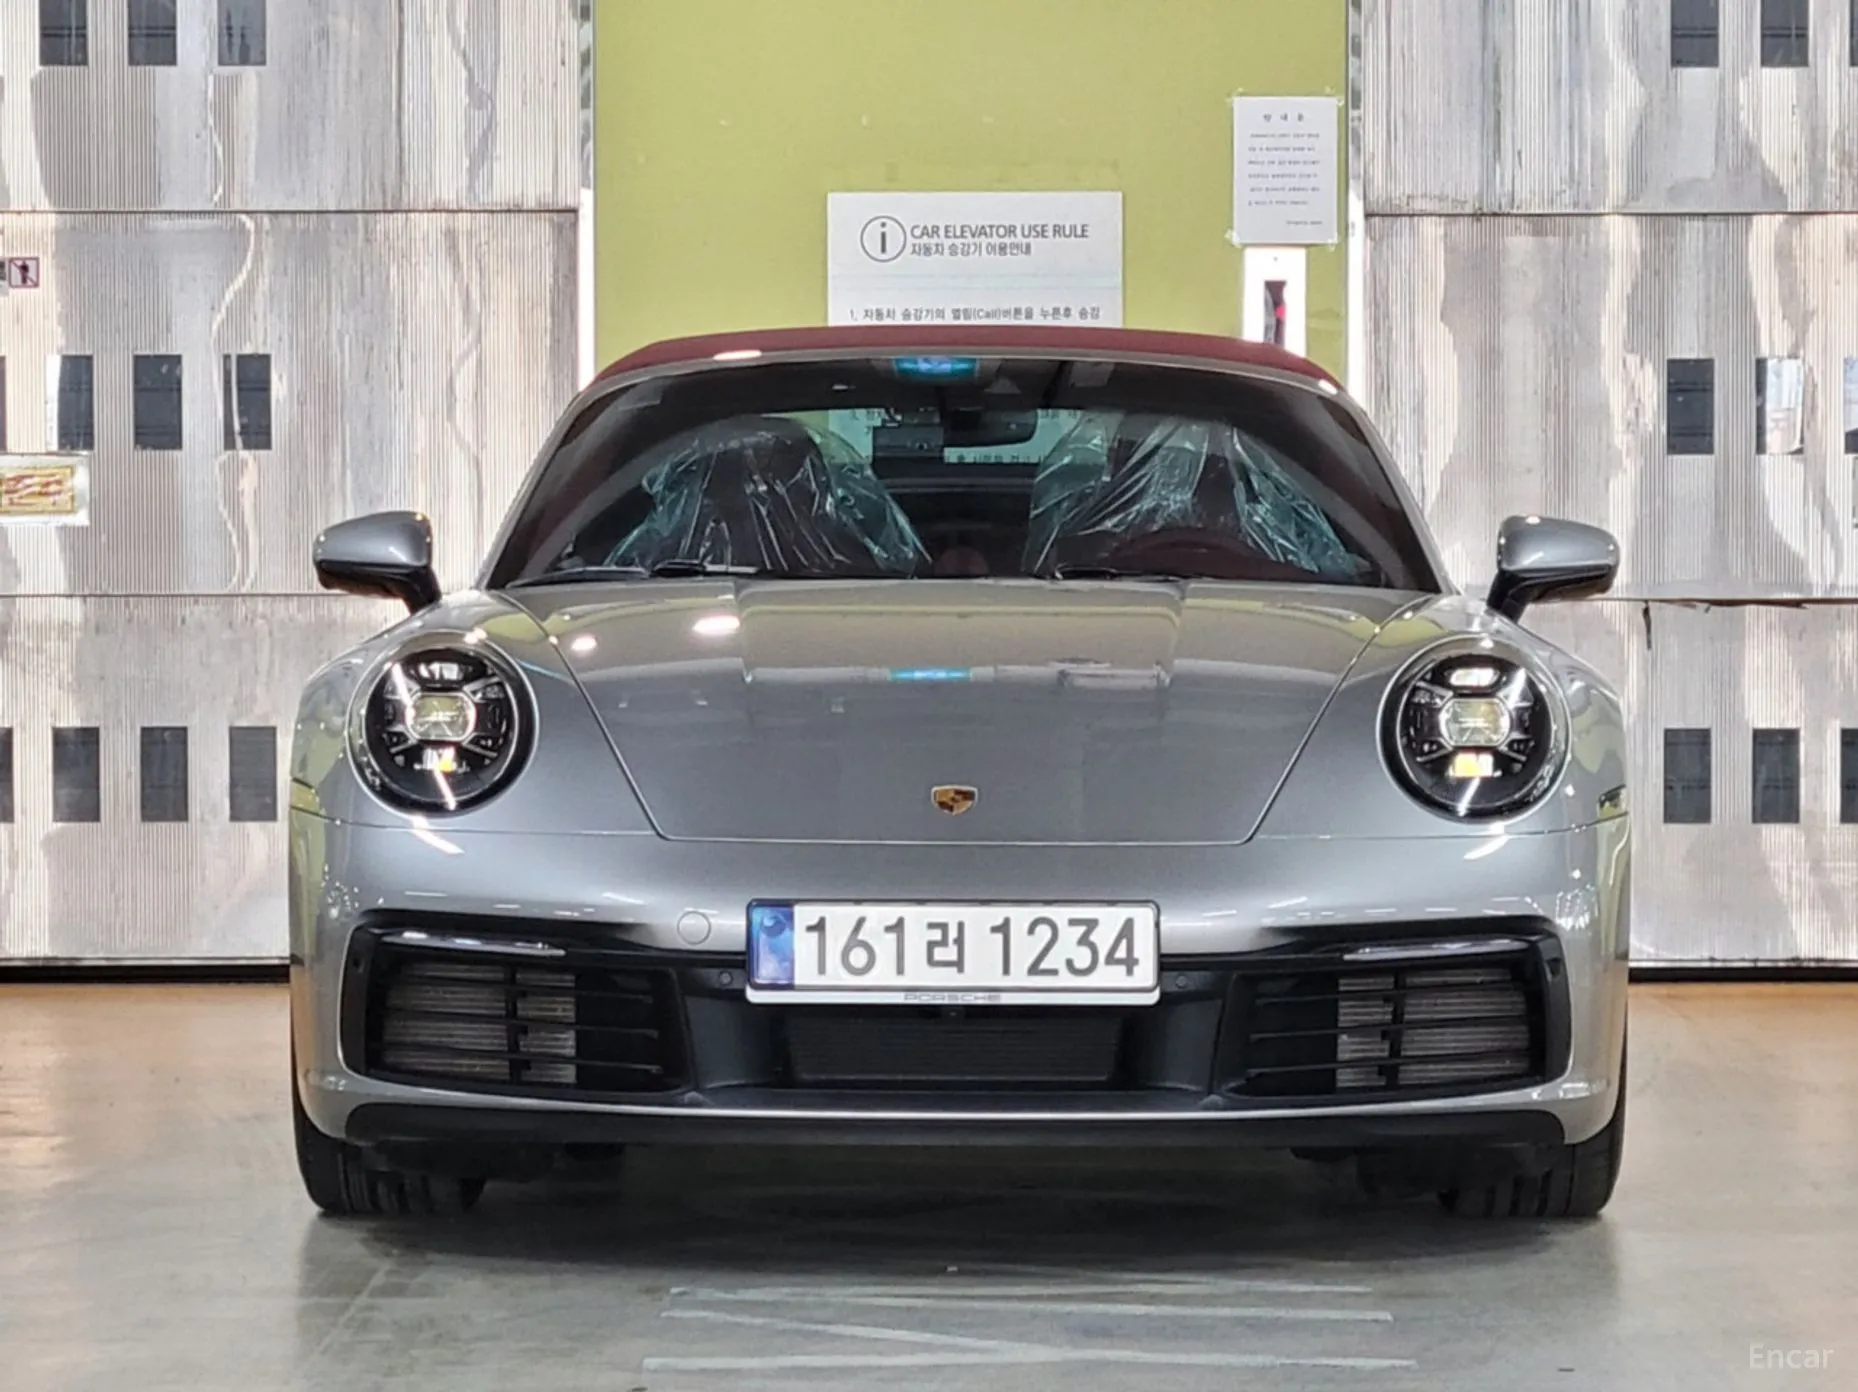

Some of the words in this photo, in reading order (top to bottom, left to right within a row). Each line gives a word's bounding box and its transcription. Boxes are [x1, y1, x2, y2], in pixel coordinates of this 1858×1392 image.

[910, 224, 941, 239] CAR
[944, 224, 1018, 239] ELEVATOR
[1021, 224, 1049, 239] USE
[1052, 224, 1089, 239] RULE
[910, 242, 945, 257] 자동차
[948, 242, 982, 257] 승강기
[986, 242, 1032, 257] 이용안내
[805, 915, 965, 977] 161러
[989, 916, 1140, 977] 1234
